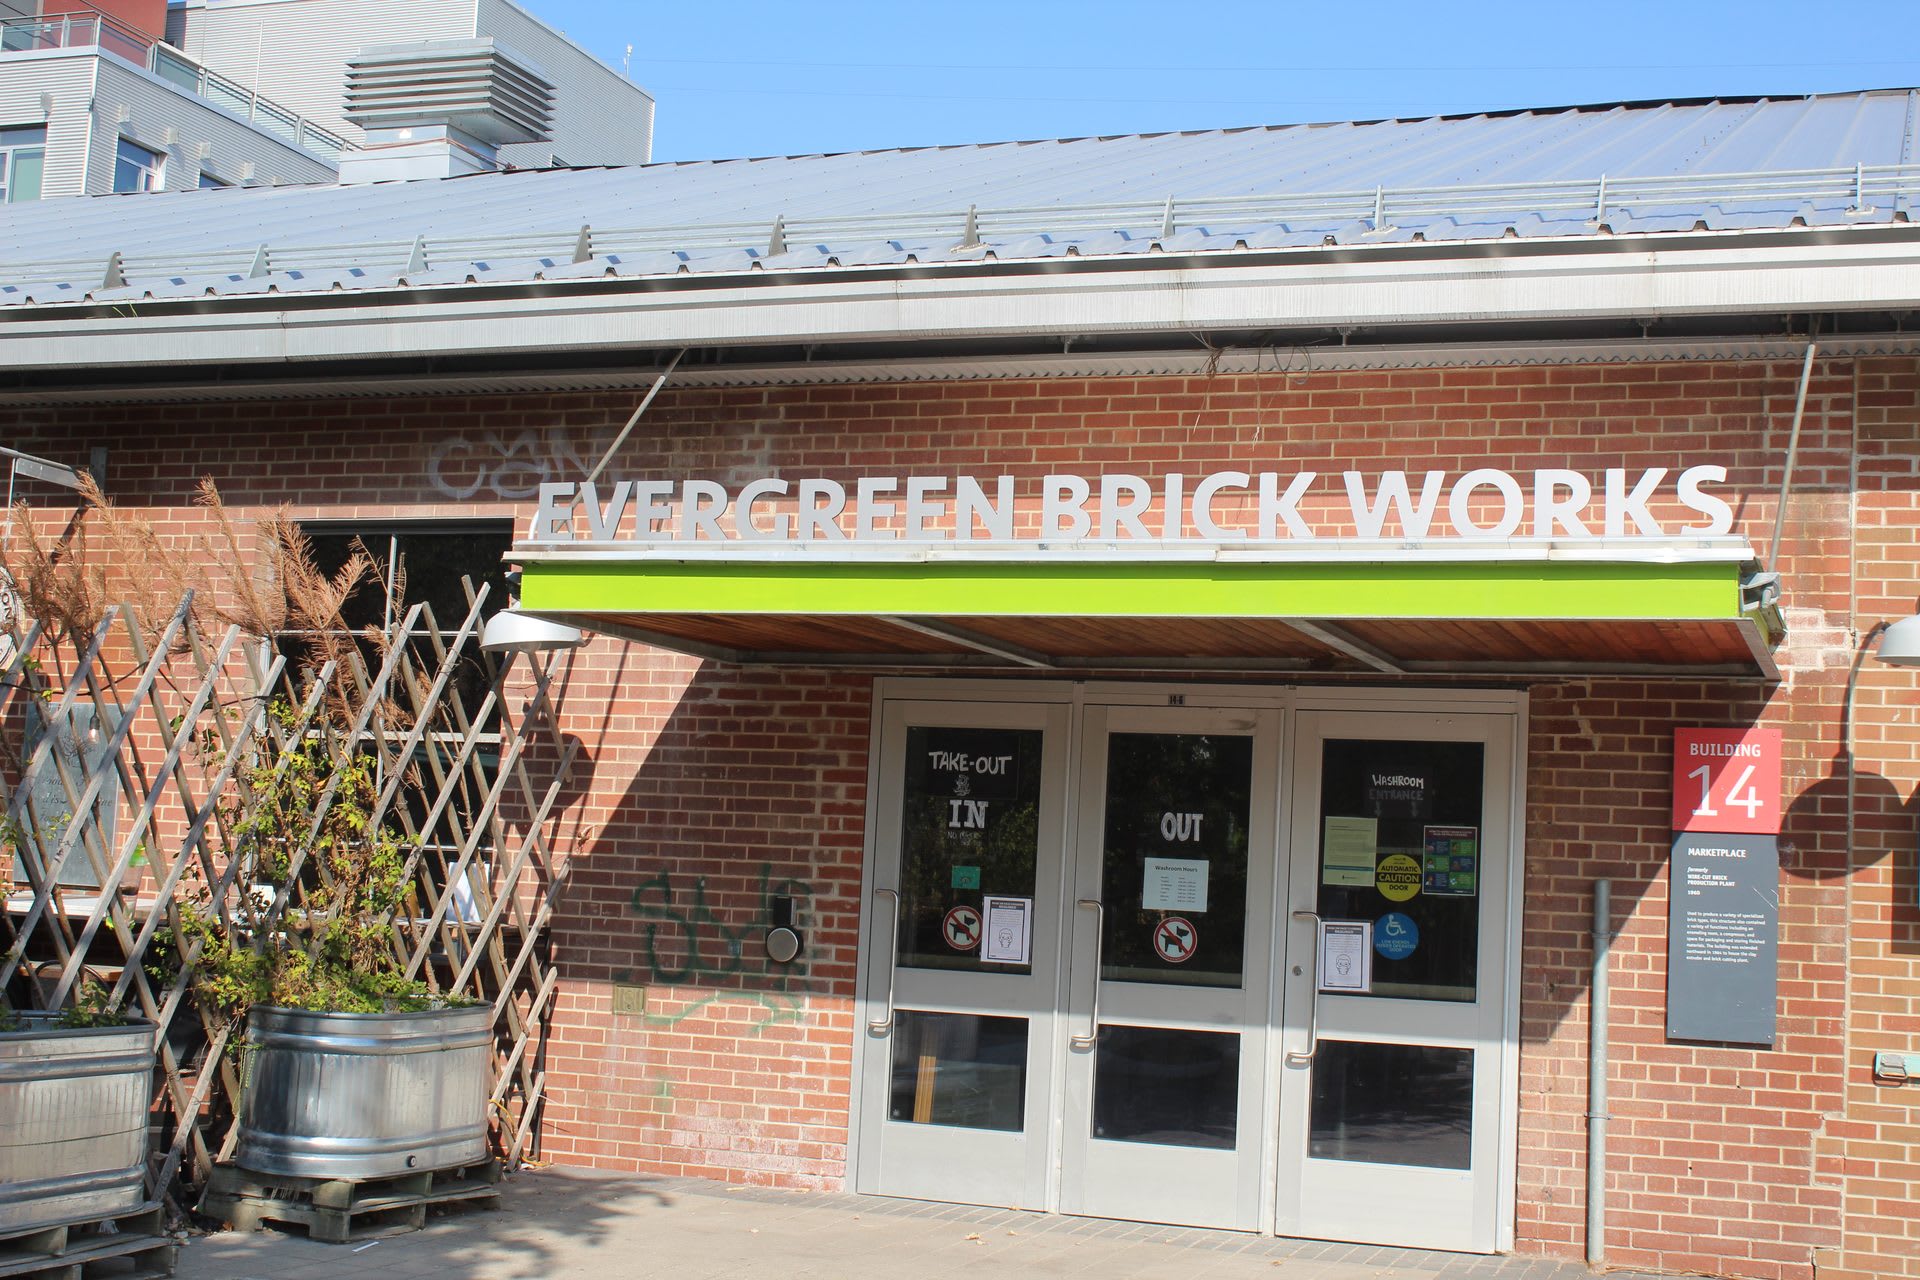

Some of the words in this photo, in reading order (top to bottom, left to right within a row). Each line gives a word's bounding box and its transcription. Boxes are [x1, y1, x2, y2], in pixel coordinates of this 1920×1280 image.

[538, 476, 1014, 540] EVERGREEN
[1042, 472, 1317, 540] BRICK
[1343, 465, 1734, 537] WORKS
[1689, 742, 1762, 758] BUILDING
[928, 751, 1012, 776] TAKE-OUT
[1372, 774, 1424, 790] WASHROOM
[1688, 764, 1764, 819] 14
[1368, 788, 1424, 800] ENTRANCE
[948, 799, 989, 829] IN
[1160, 812, 1204, 842] OUT
[1688, 848, 1746, 858] MARKETPLACE
[1378, 874, 1420, 882] CAUTION
